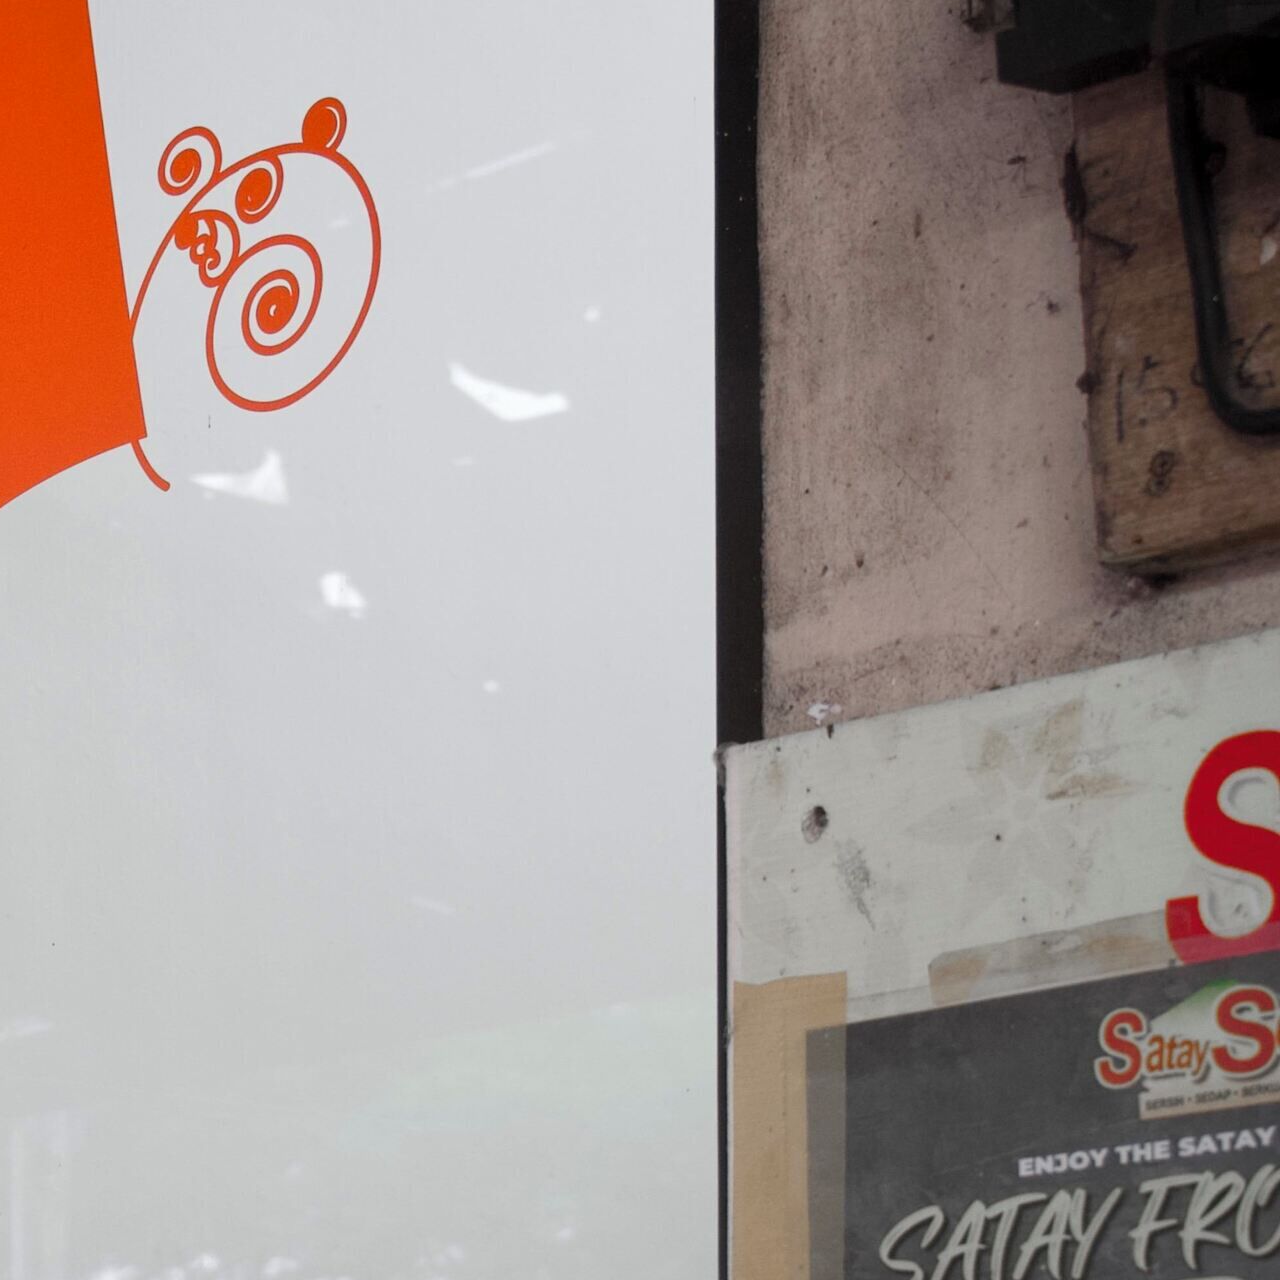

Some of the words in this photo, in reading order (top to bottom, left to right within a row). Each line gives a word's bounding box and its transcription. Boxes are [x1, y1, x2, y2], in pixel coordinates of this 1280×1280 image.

[1095, 1007, 1210, 1087] Satay
[1018, 1148, 1108, 1178] ENJOY
[1114, 1139, 1171, 1165] THE
[1177, 1125, 1277, 1158] SATAY
